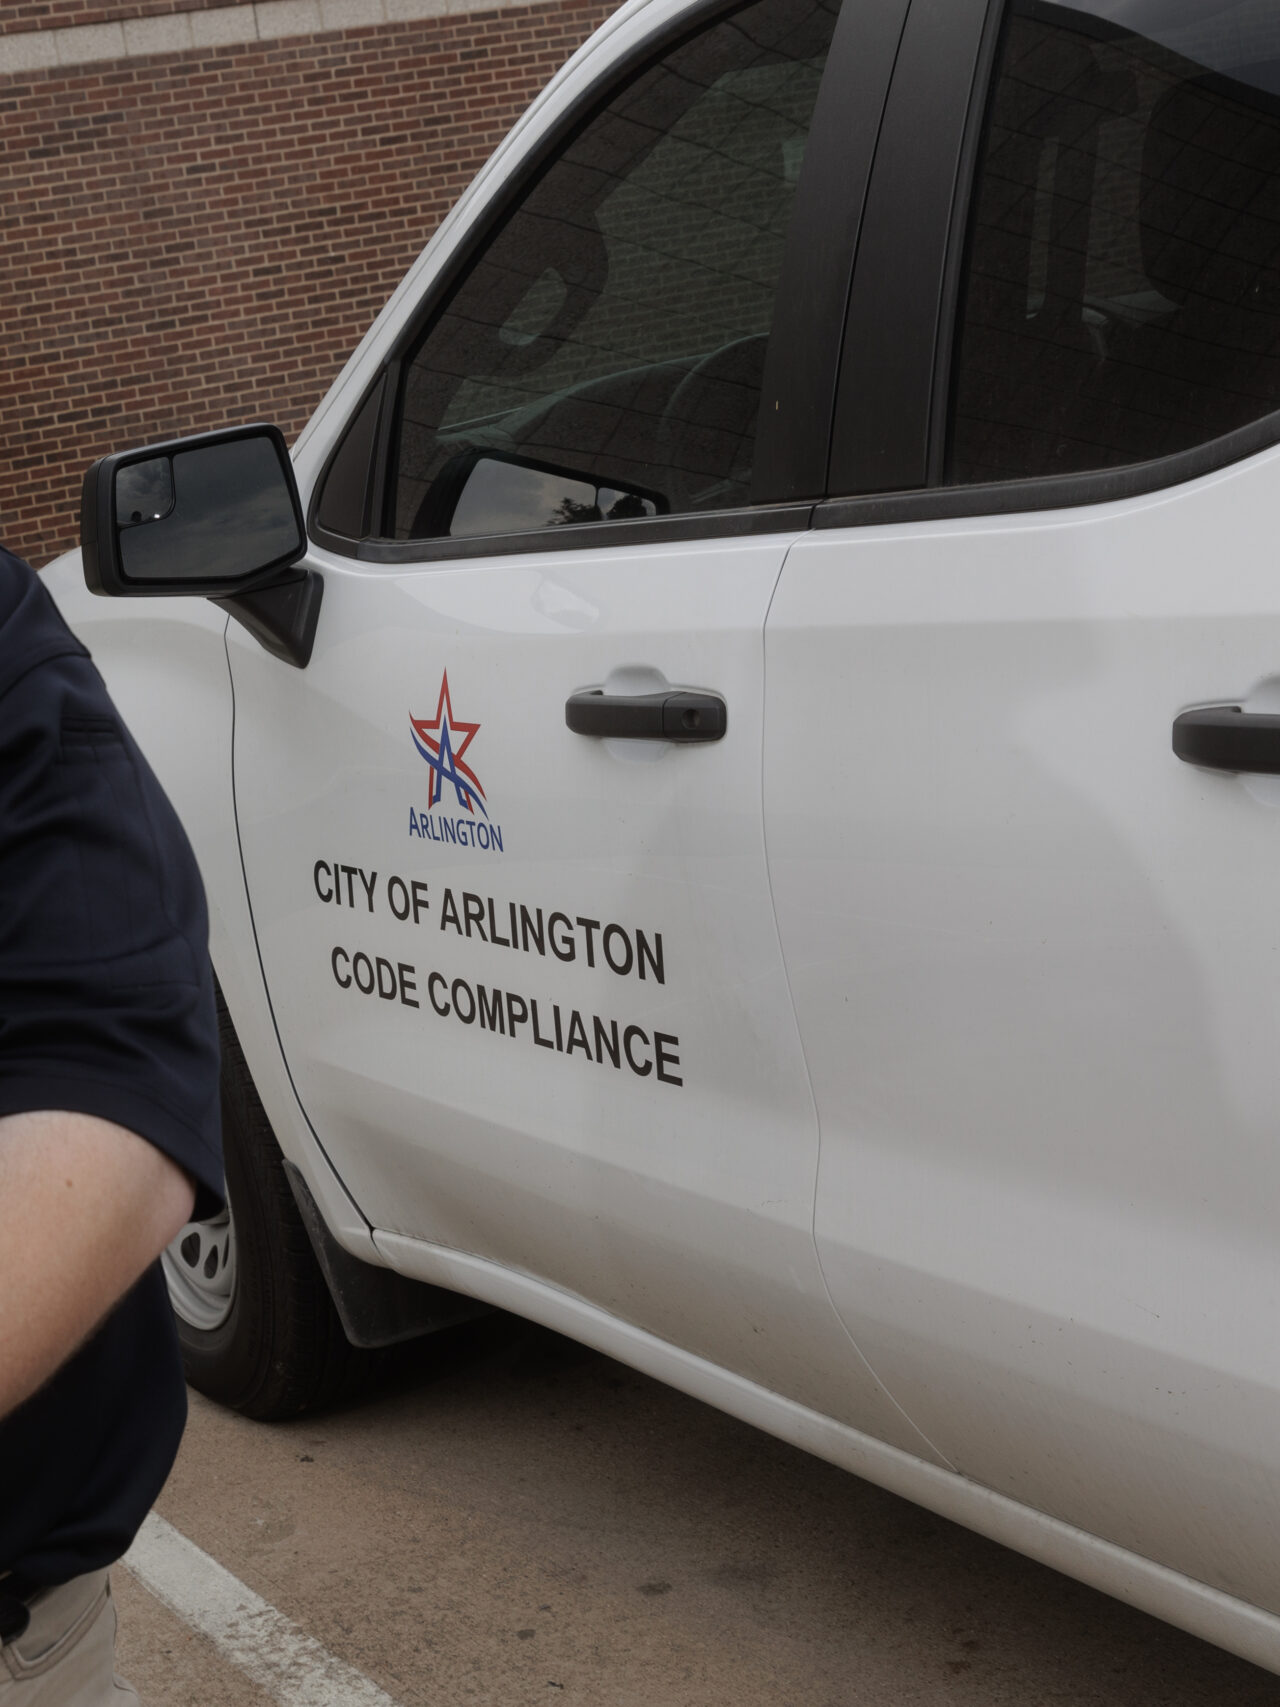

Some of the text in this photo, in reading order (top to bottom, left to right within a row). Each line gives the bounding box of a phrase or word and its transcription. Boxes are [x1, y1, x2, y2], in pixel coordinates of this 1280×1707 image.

[408, 806, 504, 853] ARLINGTON
[313, 859, 665, 985] CITY OF ARLINGTON
[331, 946, 683, 1087] CODE COMPLIANCE
